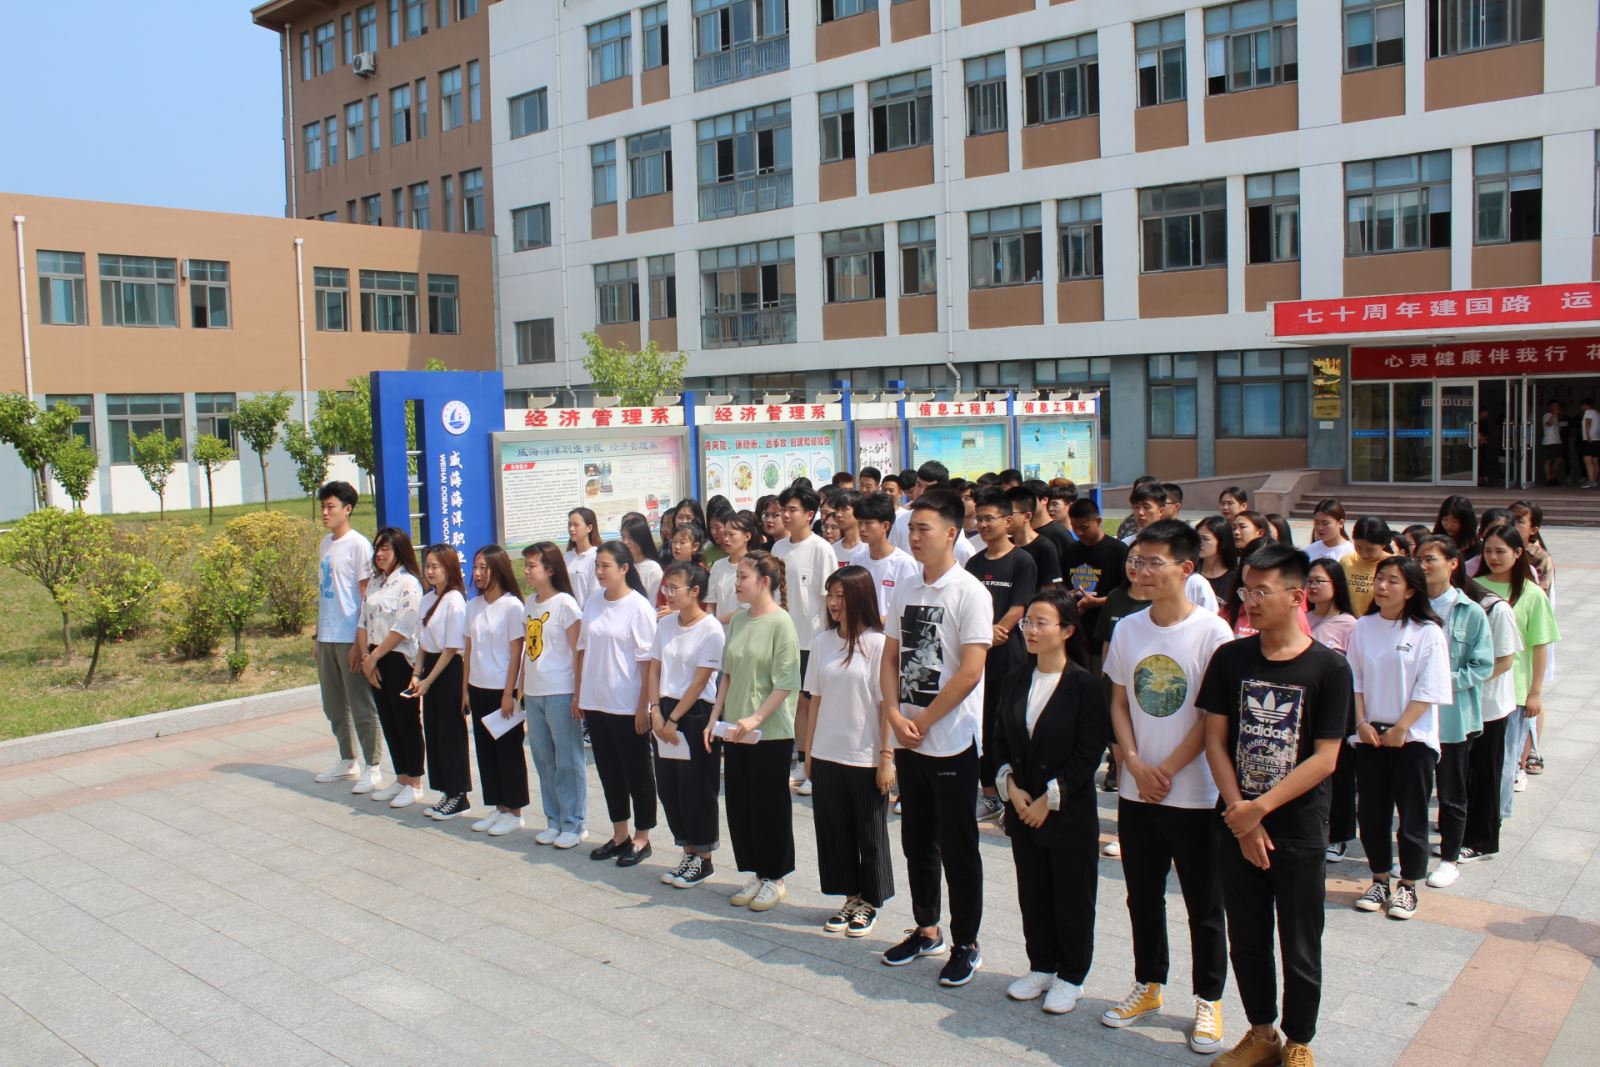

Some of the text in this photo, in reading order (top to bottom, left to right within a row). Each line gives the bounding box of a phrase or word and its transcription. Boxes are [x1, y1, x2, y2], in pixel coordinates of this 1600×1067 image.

[1298, 291, 1593, 324] 七十周年建国路 运
[1384, 346, 1568, 368] 心灵健康伴我行
[714, 404, 826, 422] 经济管理系
[919, 402, 996, 417] 信息工程系
[1024, 401, 1087, 414] 信息工程系
[524, 407, 669, 427] 经济管理系
[1244, 723, 1290, 740] adidas
